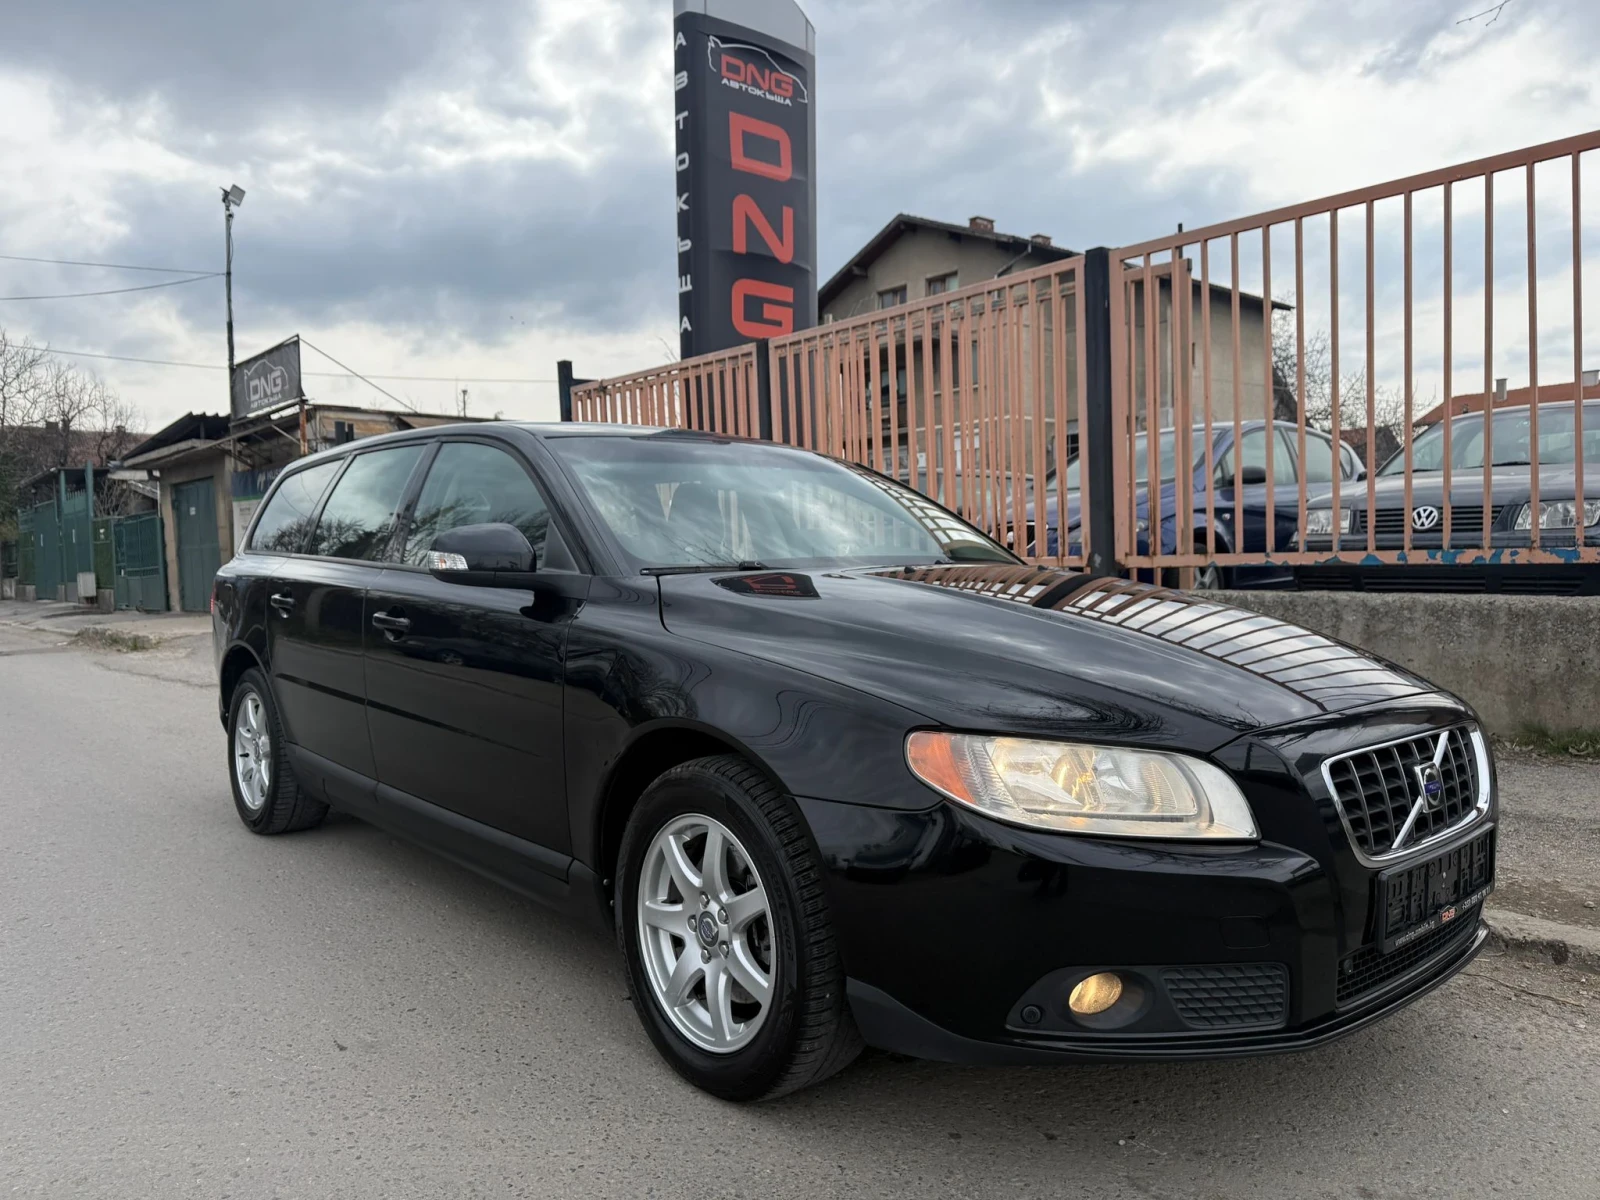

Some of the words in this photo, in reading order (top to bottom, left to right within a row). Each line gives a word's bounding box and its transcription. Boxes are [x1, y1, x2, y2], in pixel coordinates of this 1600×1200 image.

[721, 54, 793, 97] DNG
[729, 111, 794, 340] DNG
[250, 371, 282, 401] DNG
